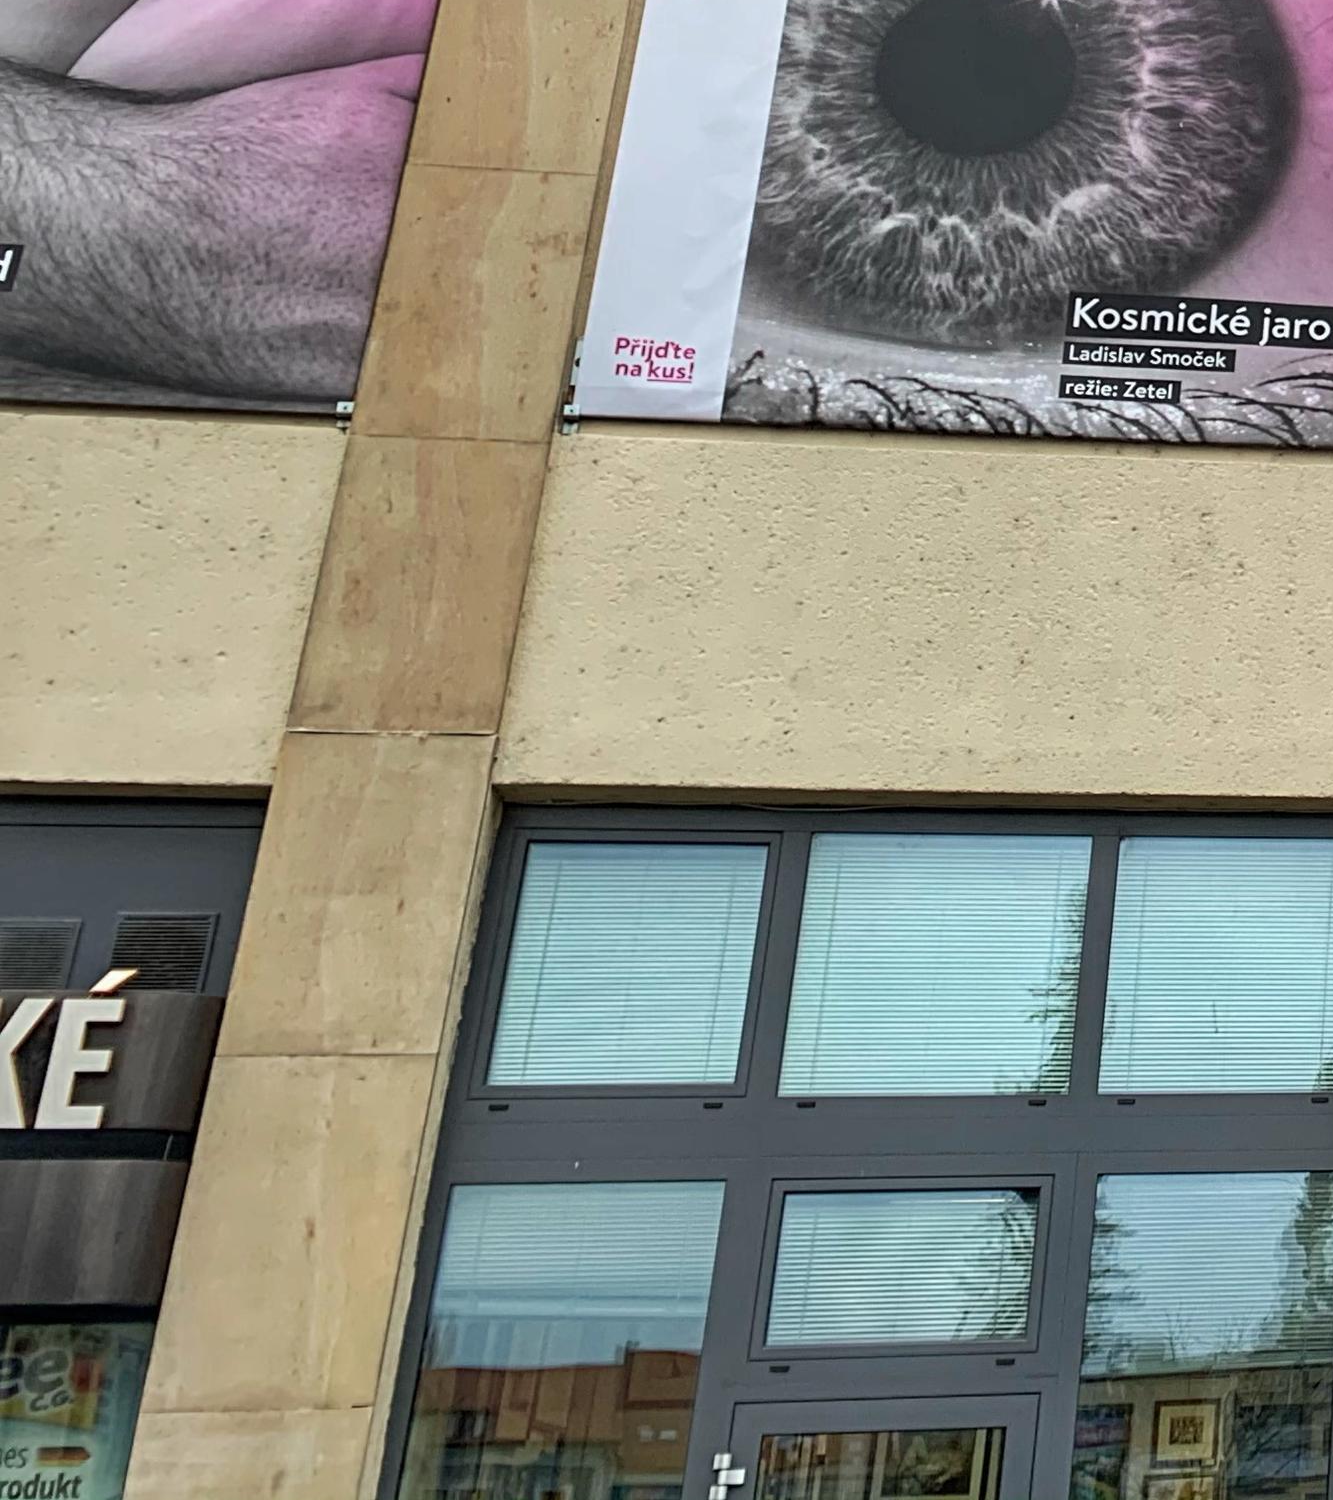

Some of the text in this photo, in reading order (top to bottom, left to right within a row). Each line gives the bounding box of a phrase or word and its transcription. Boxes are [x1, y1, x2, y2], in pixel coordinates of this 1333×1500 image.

[1071, 297, 1332, 347] Kosmické jaro
[614, 337, 696, 362] Přijďte
[1068, 345, 1227, 369] Ladislav Smoček
[615, 360, 694, 381] na kus!
[1064, 380, 1174, 400] režie: Zetel
